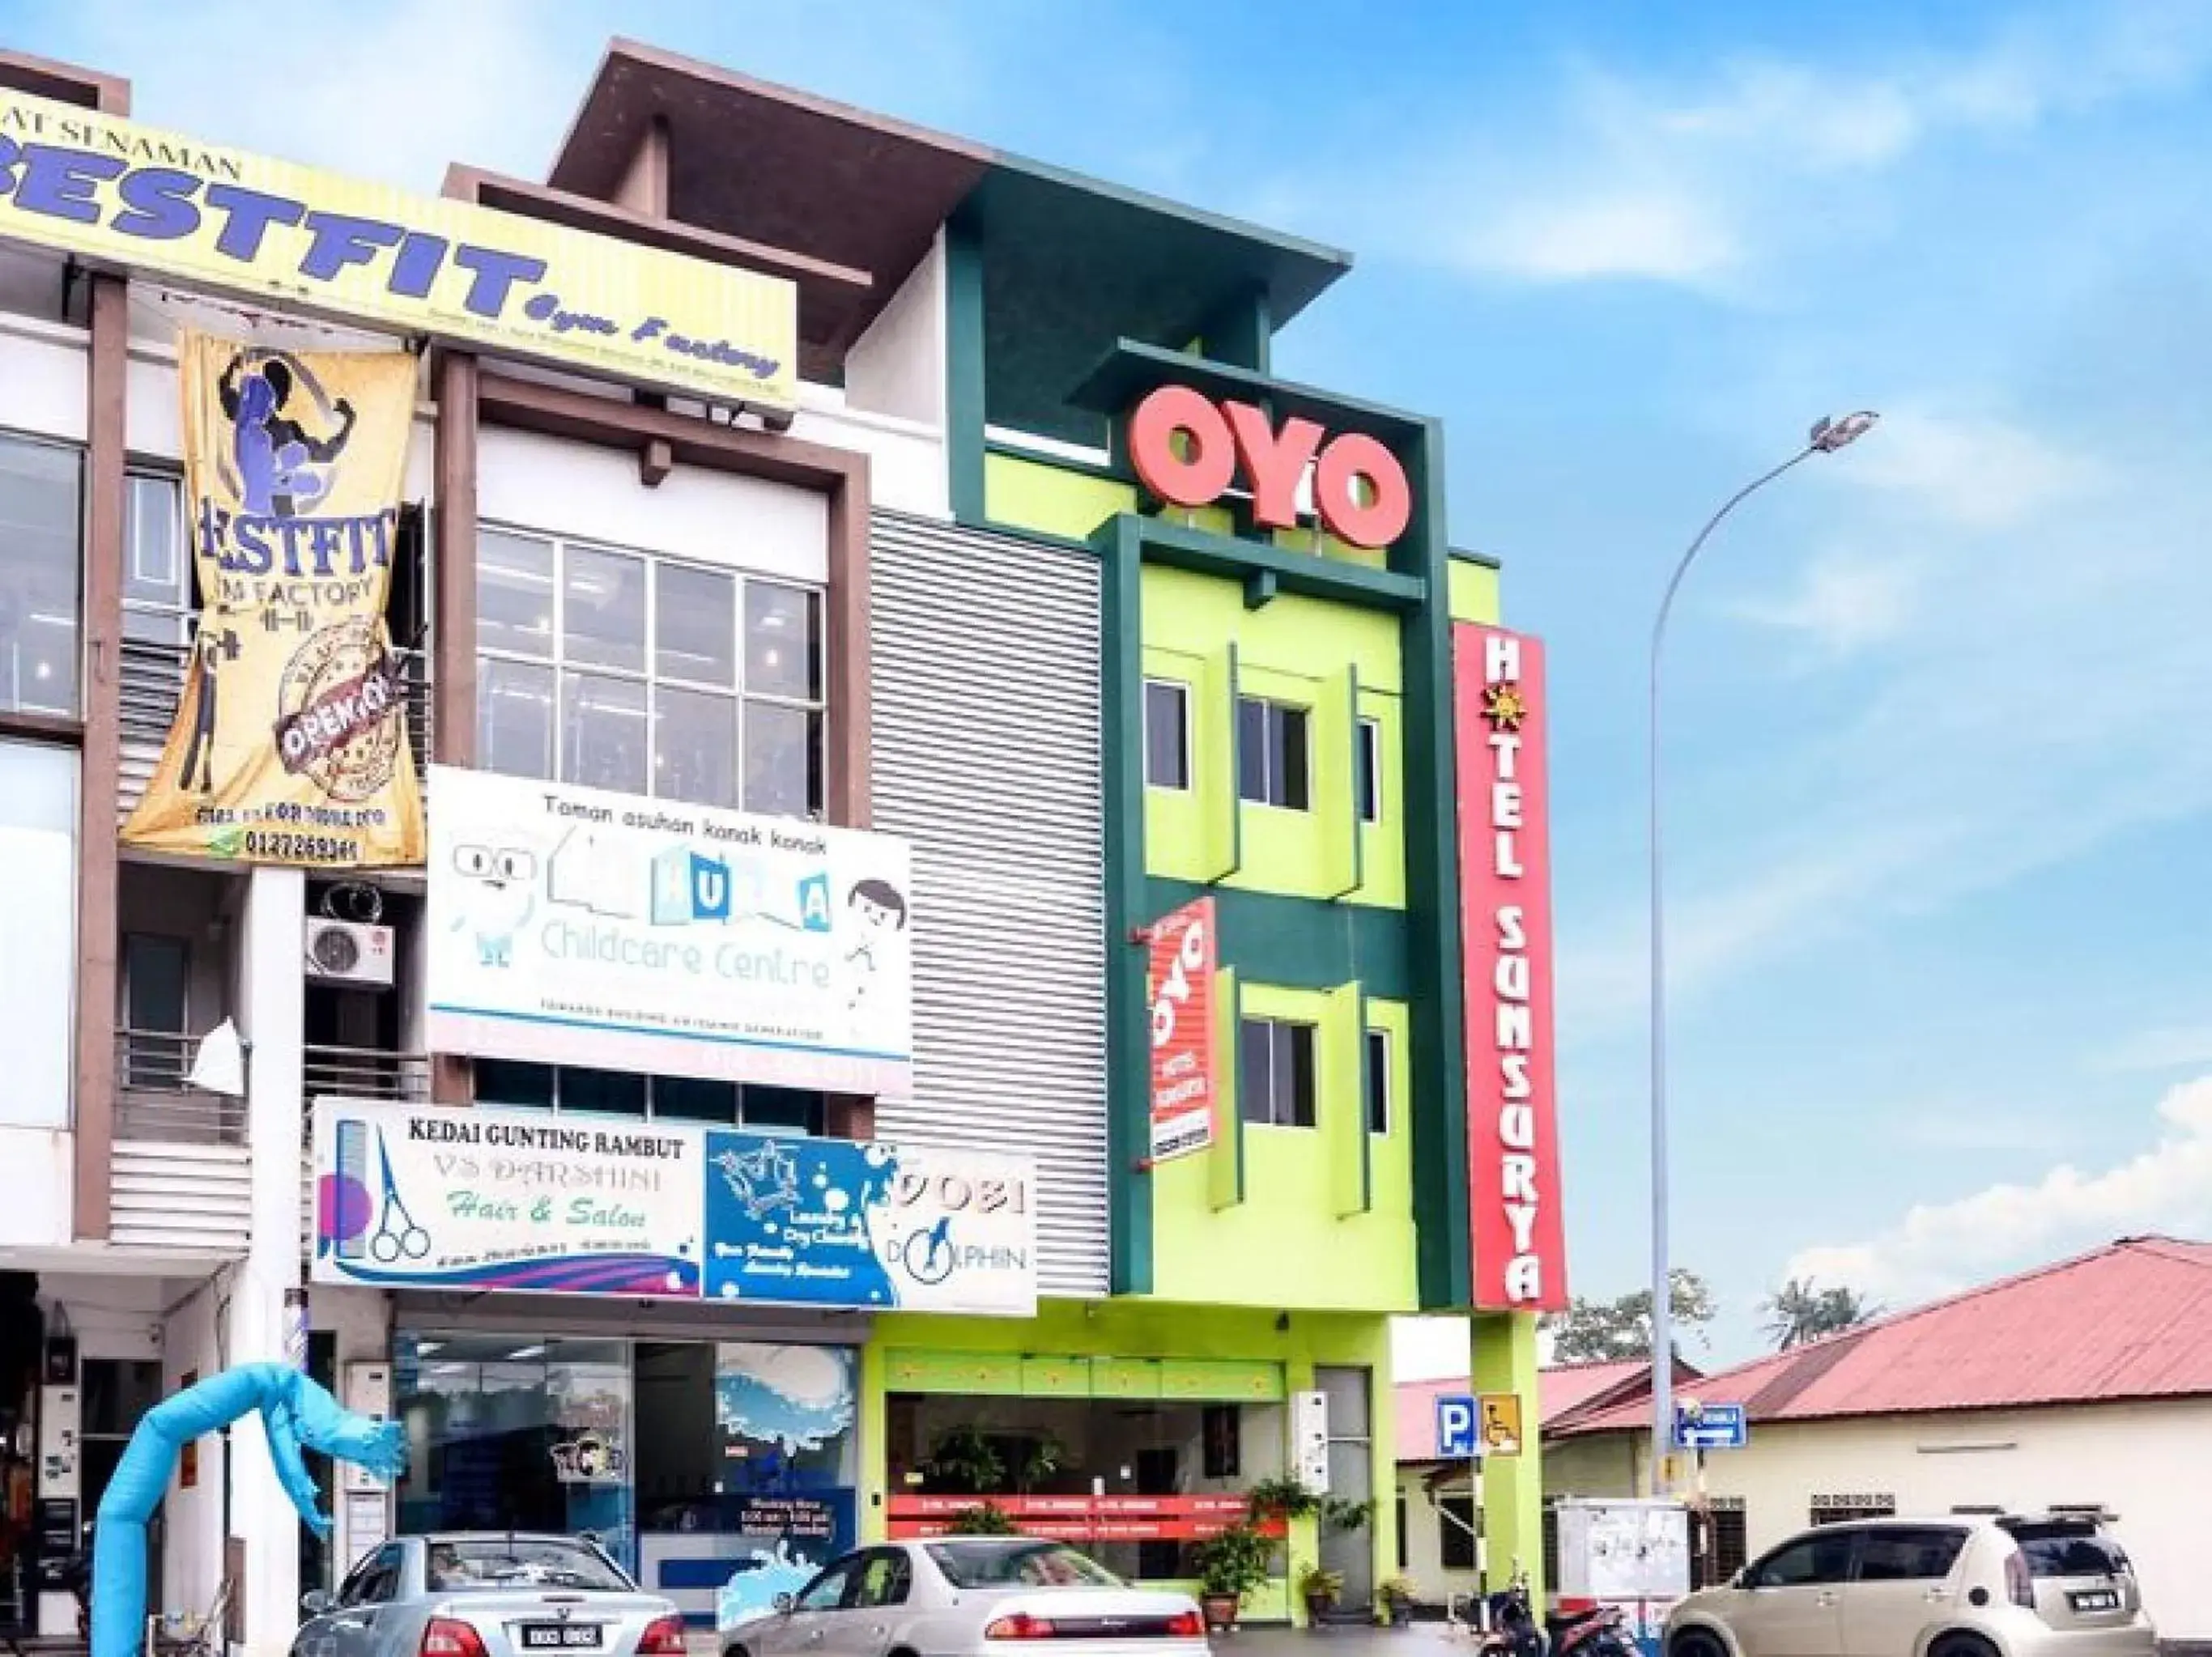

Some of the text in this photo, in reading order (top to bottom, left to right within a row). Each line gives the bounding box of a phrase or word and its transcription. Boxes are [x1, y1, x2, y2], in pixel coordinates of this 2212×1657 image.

[59, 119, 242, 181] SENAMAN
[0, 133, 547, 317] ESTFIT
[1129, 385, 1411, 548] OYO
[545, 794, 827, 856] Taman asuhan kanak kanak
[541, 917, 831, 989] Childcare Centre
[409, 1118, 686, 1159] KEDAI GUNTING RAMBUT
[433, 1155, 480, 1179] VS
[446, 1191, 647, 1227] Hair & Salon
[1443, 1404, 1469, 1447] P
